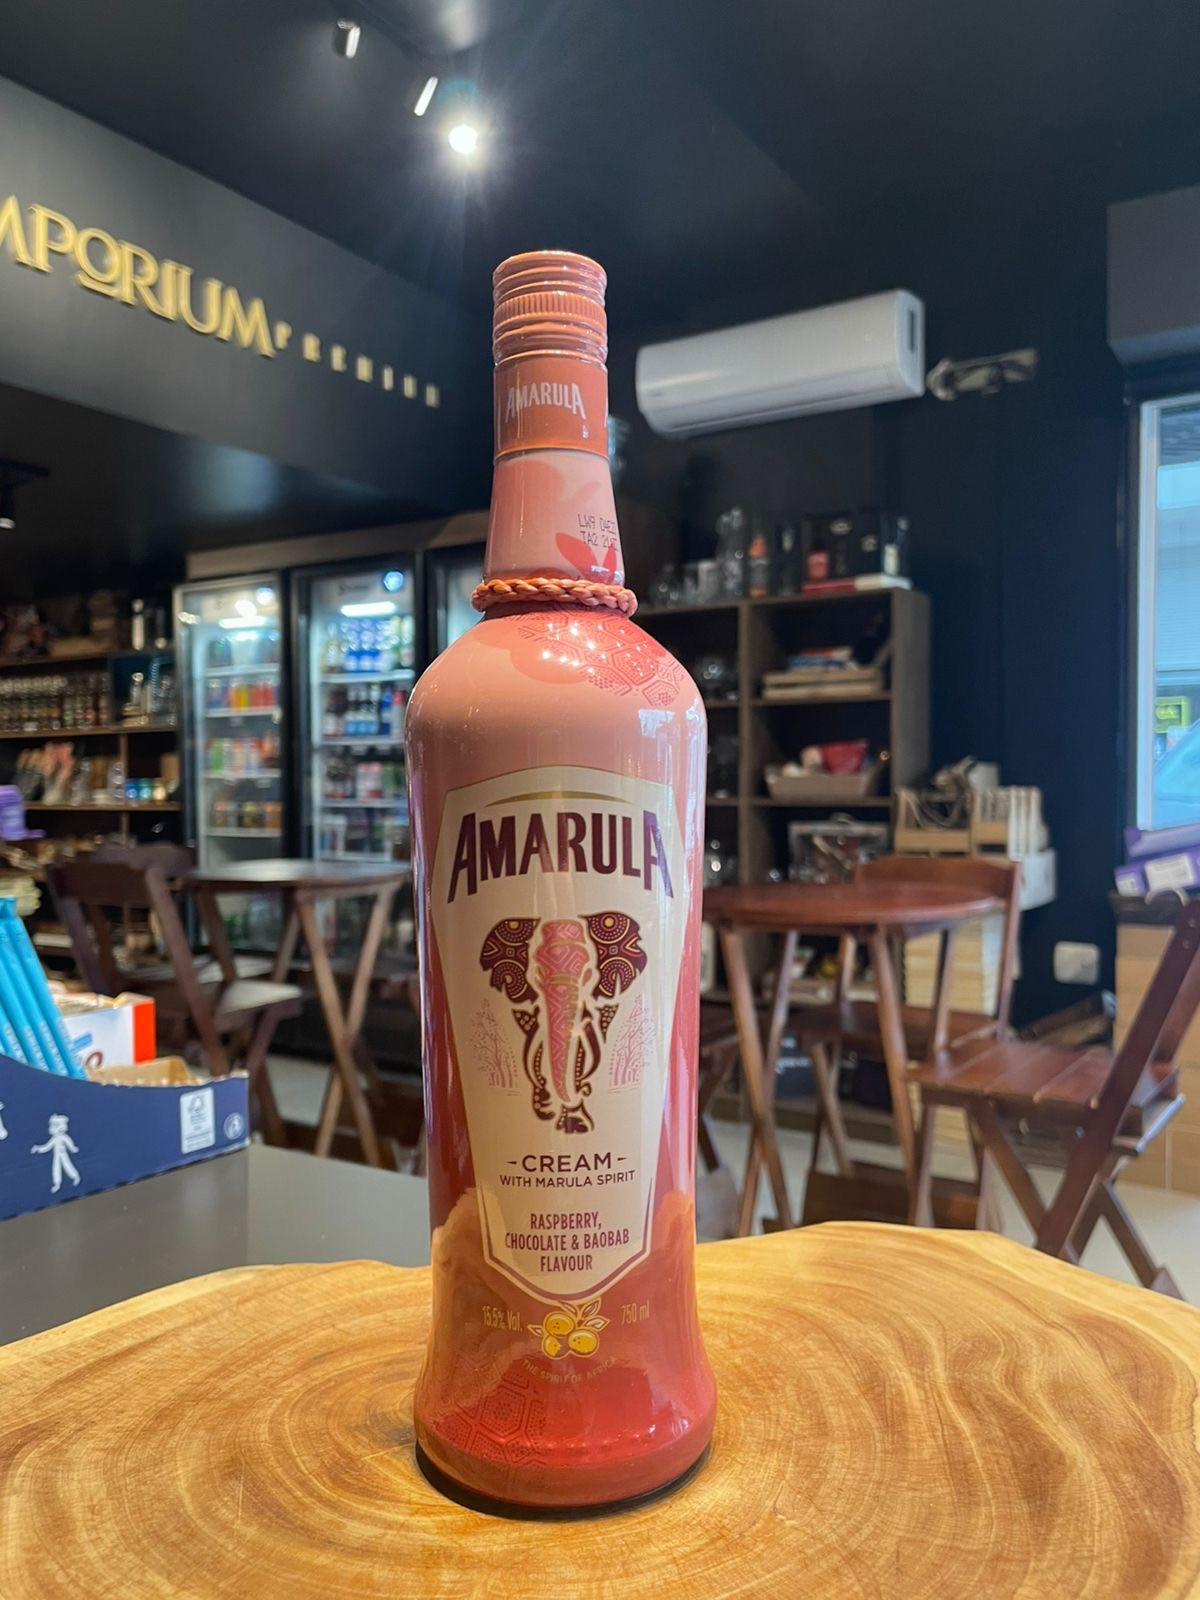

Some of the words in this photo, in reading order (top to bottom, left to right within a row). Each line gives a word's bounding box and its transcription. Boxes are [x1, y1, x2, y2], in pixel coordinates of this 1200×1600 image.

[505, 382, 587, 424] AMARULA
[447, 810, 674, 904] AMARULA
[521, 1152, 612, 1173] CREAM
[499, 1174, 532, 1188] WITH
[535, 1176, 593, 1188] MARULA
[597, 1170, 636, 1186] SPIRIT
[530, 1211, 602, 1230] RASPBERRY,
[505, 1231, 567, 1251] CHOCOLATE
[571, 1233, 580, 1250] &
[584, 1228, 630, 1250] BAOBAB
[540, 1254, 593, 1272] FLAVOUR
[620, 1303, 637, 1325] 750
[639, 1300, 650, 1320] ml
